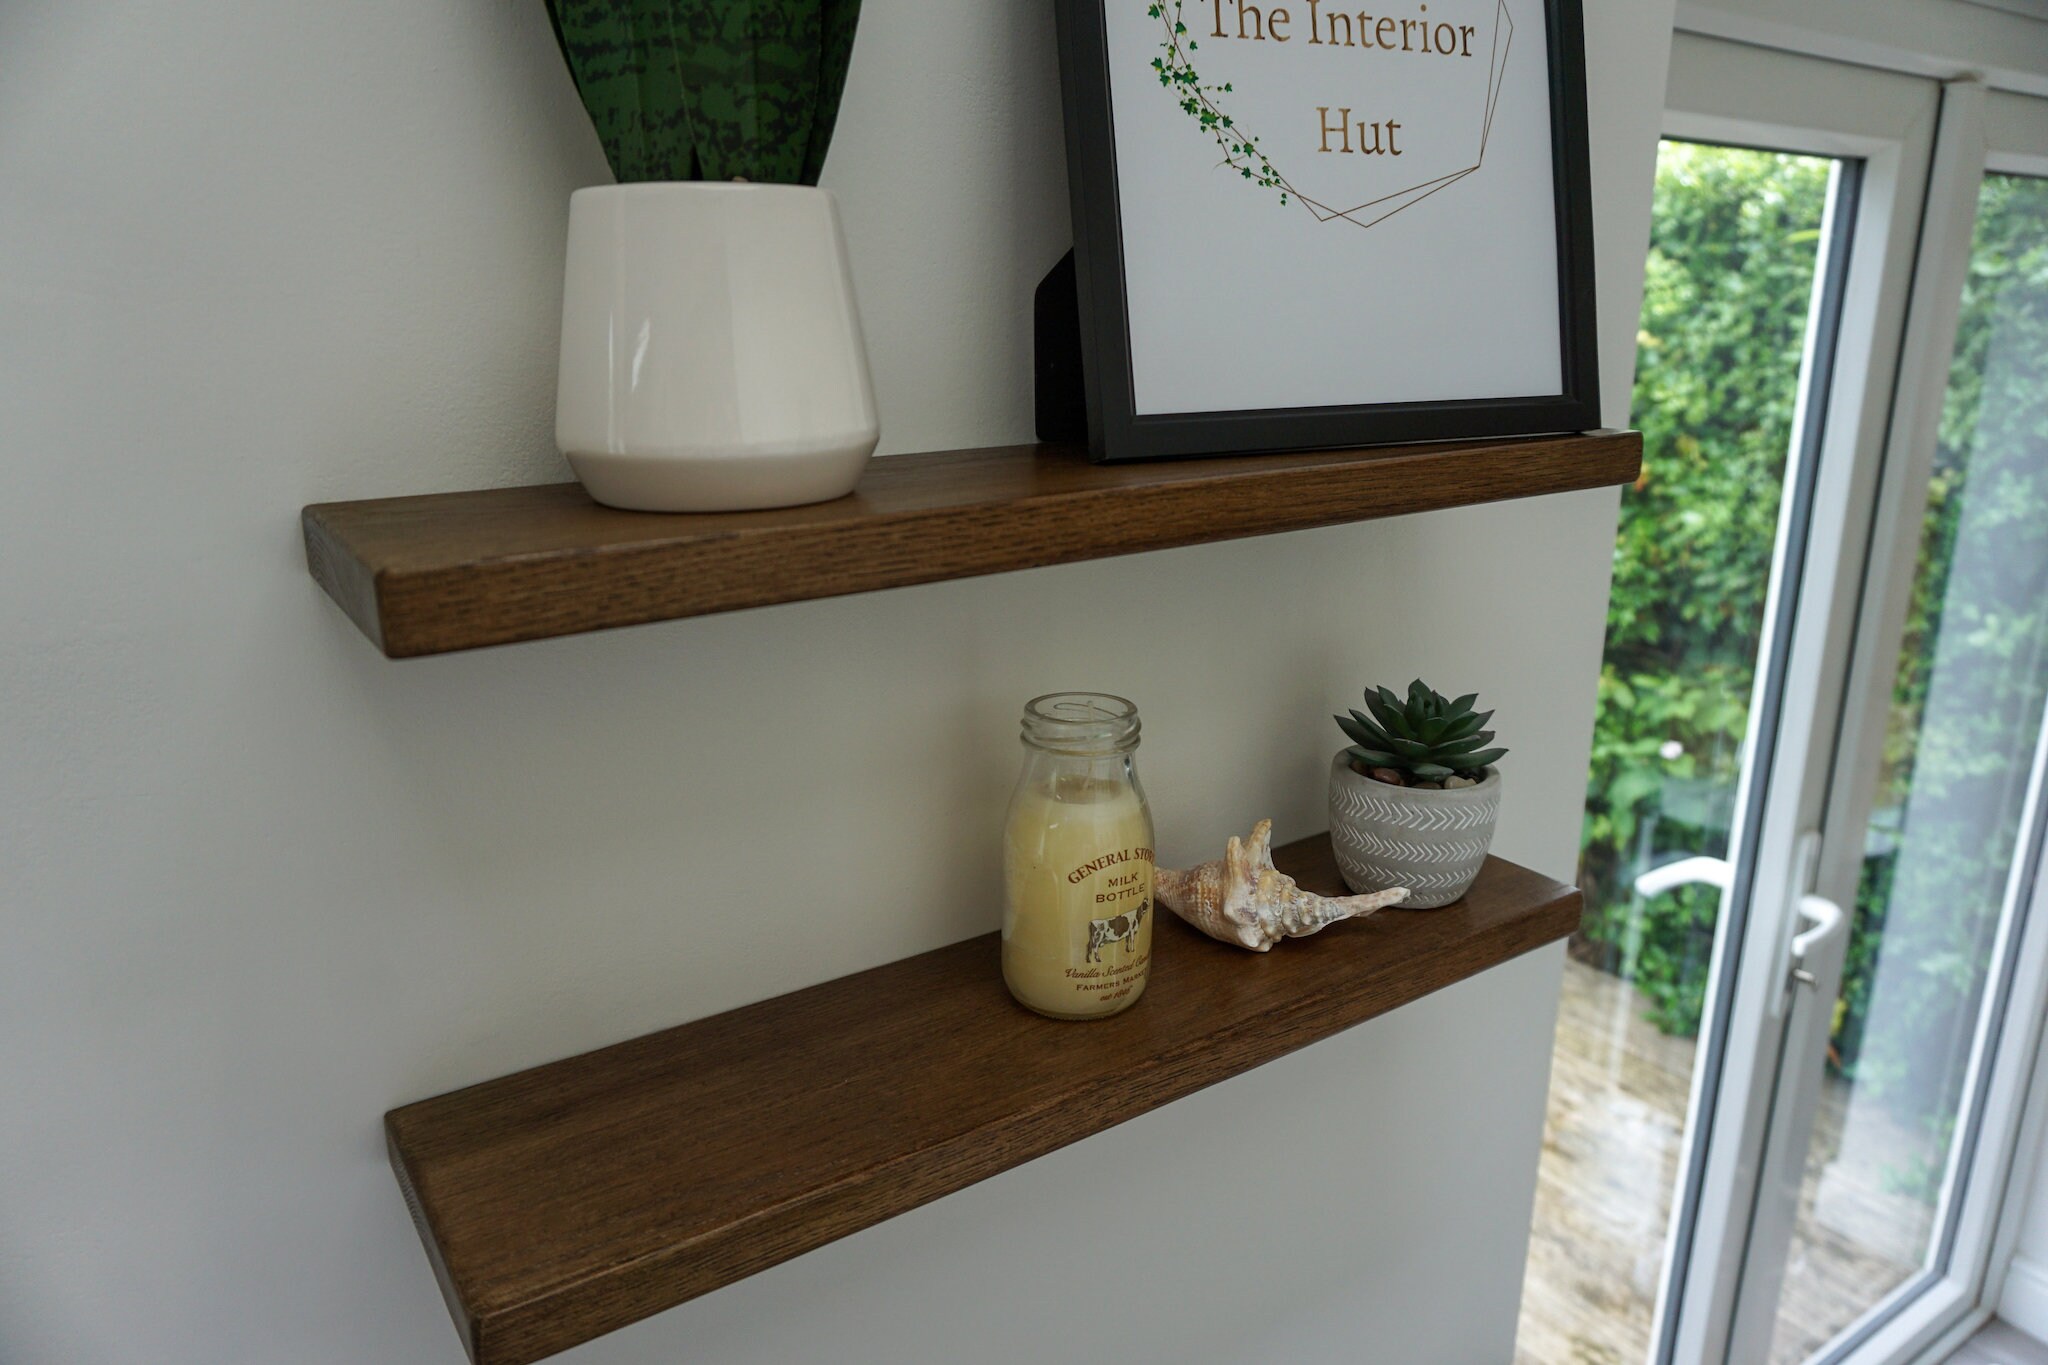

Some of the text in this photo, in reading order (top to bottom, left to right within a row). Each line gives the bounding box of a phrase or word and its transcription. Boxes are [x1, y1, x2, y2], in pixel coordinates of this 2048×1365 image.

[1205, 0, 1476, 57] The Interior
[1315, 106, 1403, 157] Hut
[1067, 848, 1131, 885] GENERAL
[1107, 871, 1139, 888] MILK
[1095, 883, 1145, 903] BOTTLE
[1064, 968, 1100, 979] Vanilla
[1101, 958, 1137, 978] Scented
[1076, 981, 1121, 992] FARMERS
